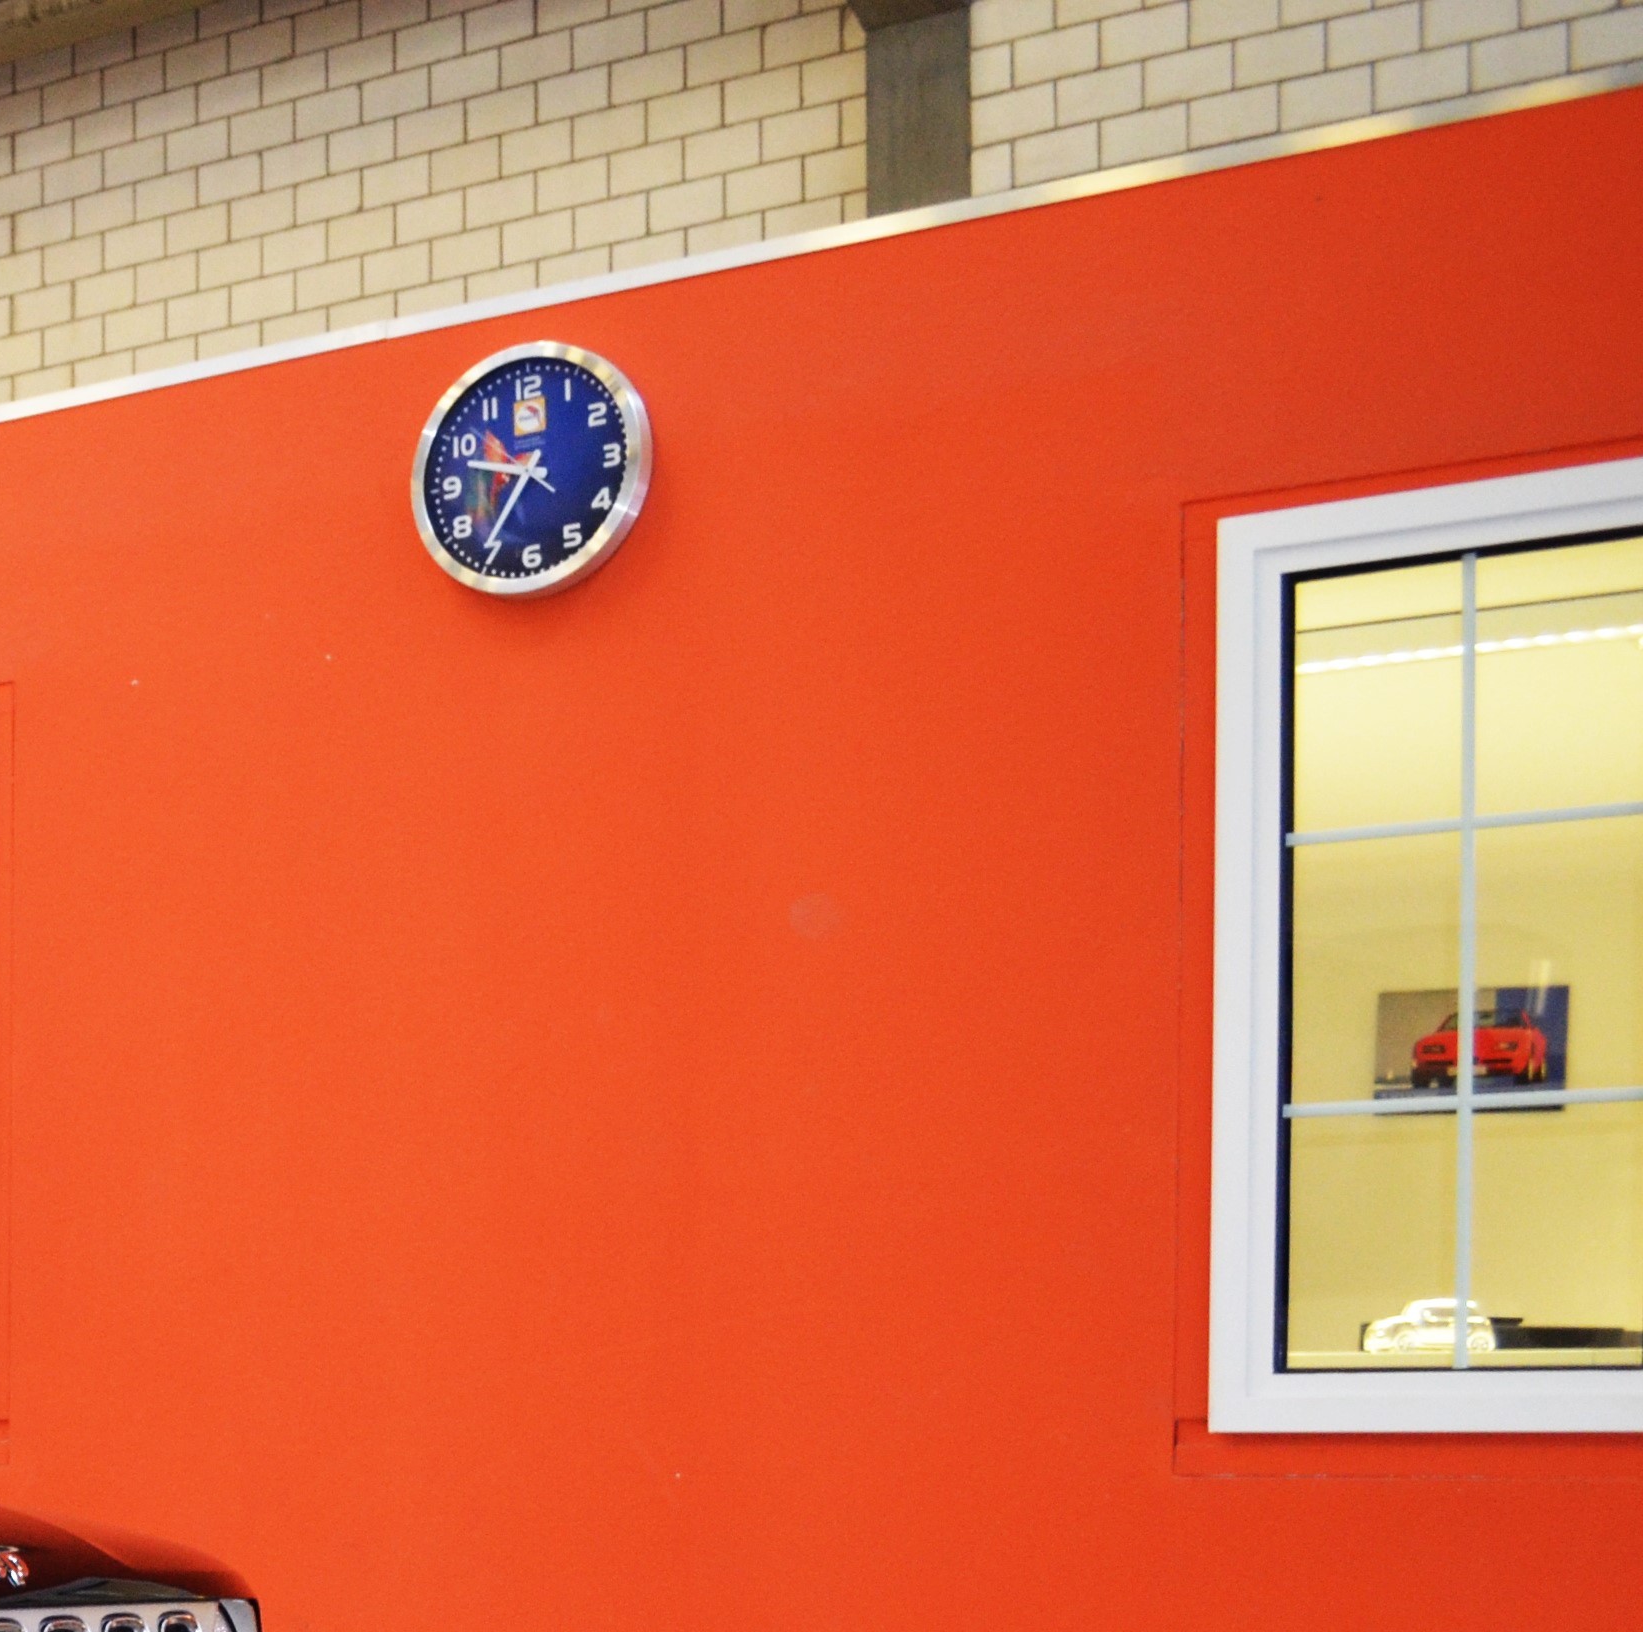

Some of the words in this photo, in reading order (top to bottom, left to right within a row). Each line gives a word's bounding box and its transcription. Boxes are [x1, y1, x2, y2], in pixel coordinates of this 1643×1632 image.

[515, 375, 541, 400] 12
[565, 379, 571, 401] 1
[482, 398, 498, 420] 11
[588, 403, 607, 427] 2
[453, 433, 476, 457] 10
[603, 443, 621, 468] 3
[443, 477, 462, 500] 9
[591, 488, 612, 510] 4
[453, 515, 472, 538] 8
[563, 524, 582, 548] 5
[522, 545, 541, 568] 6
